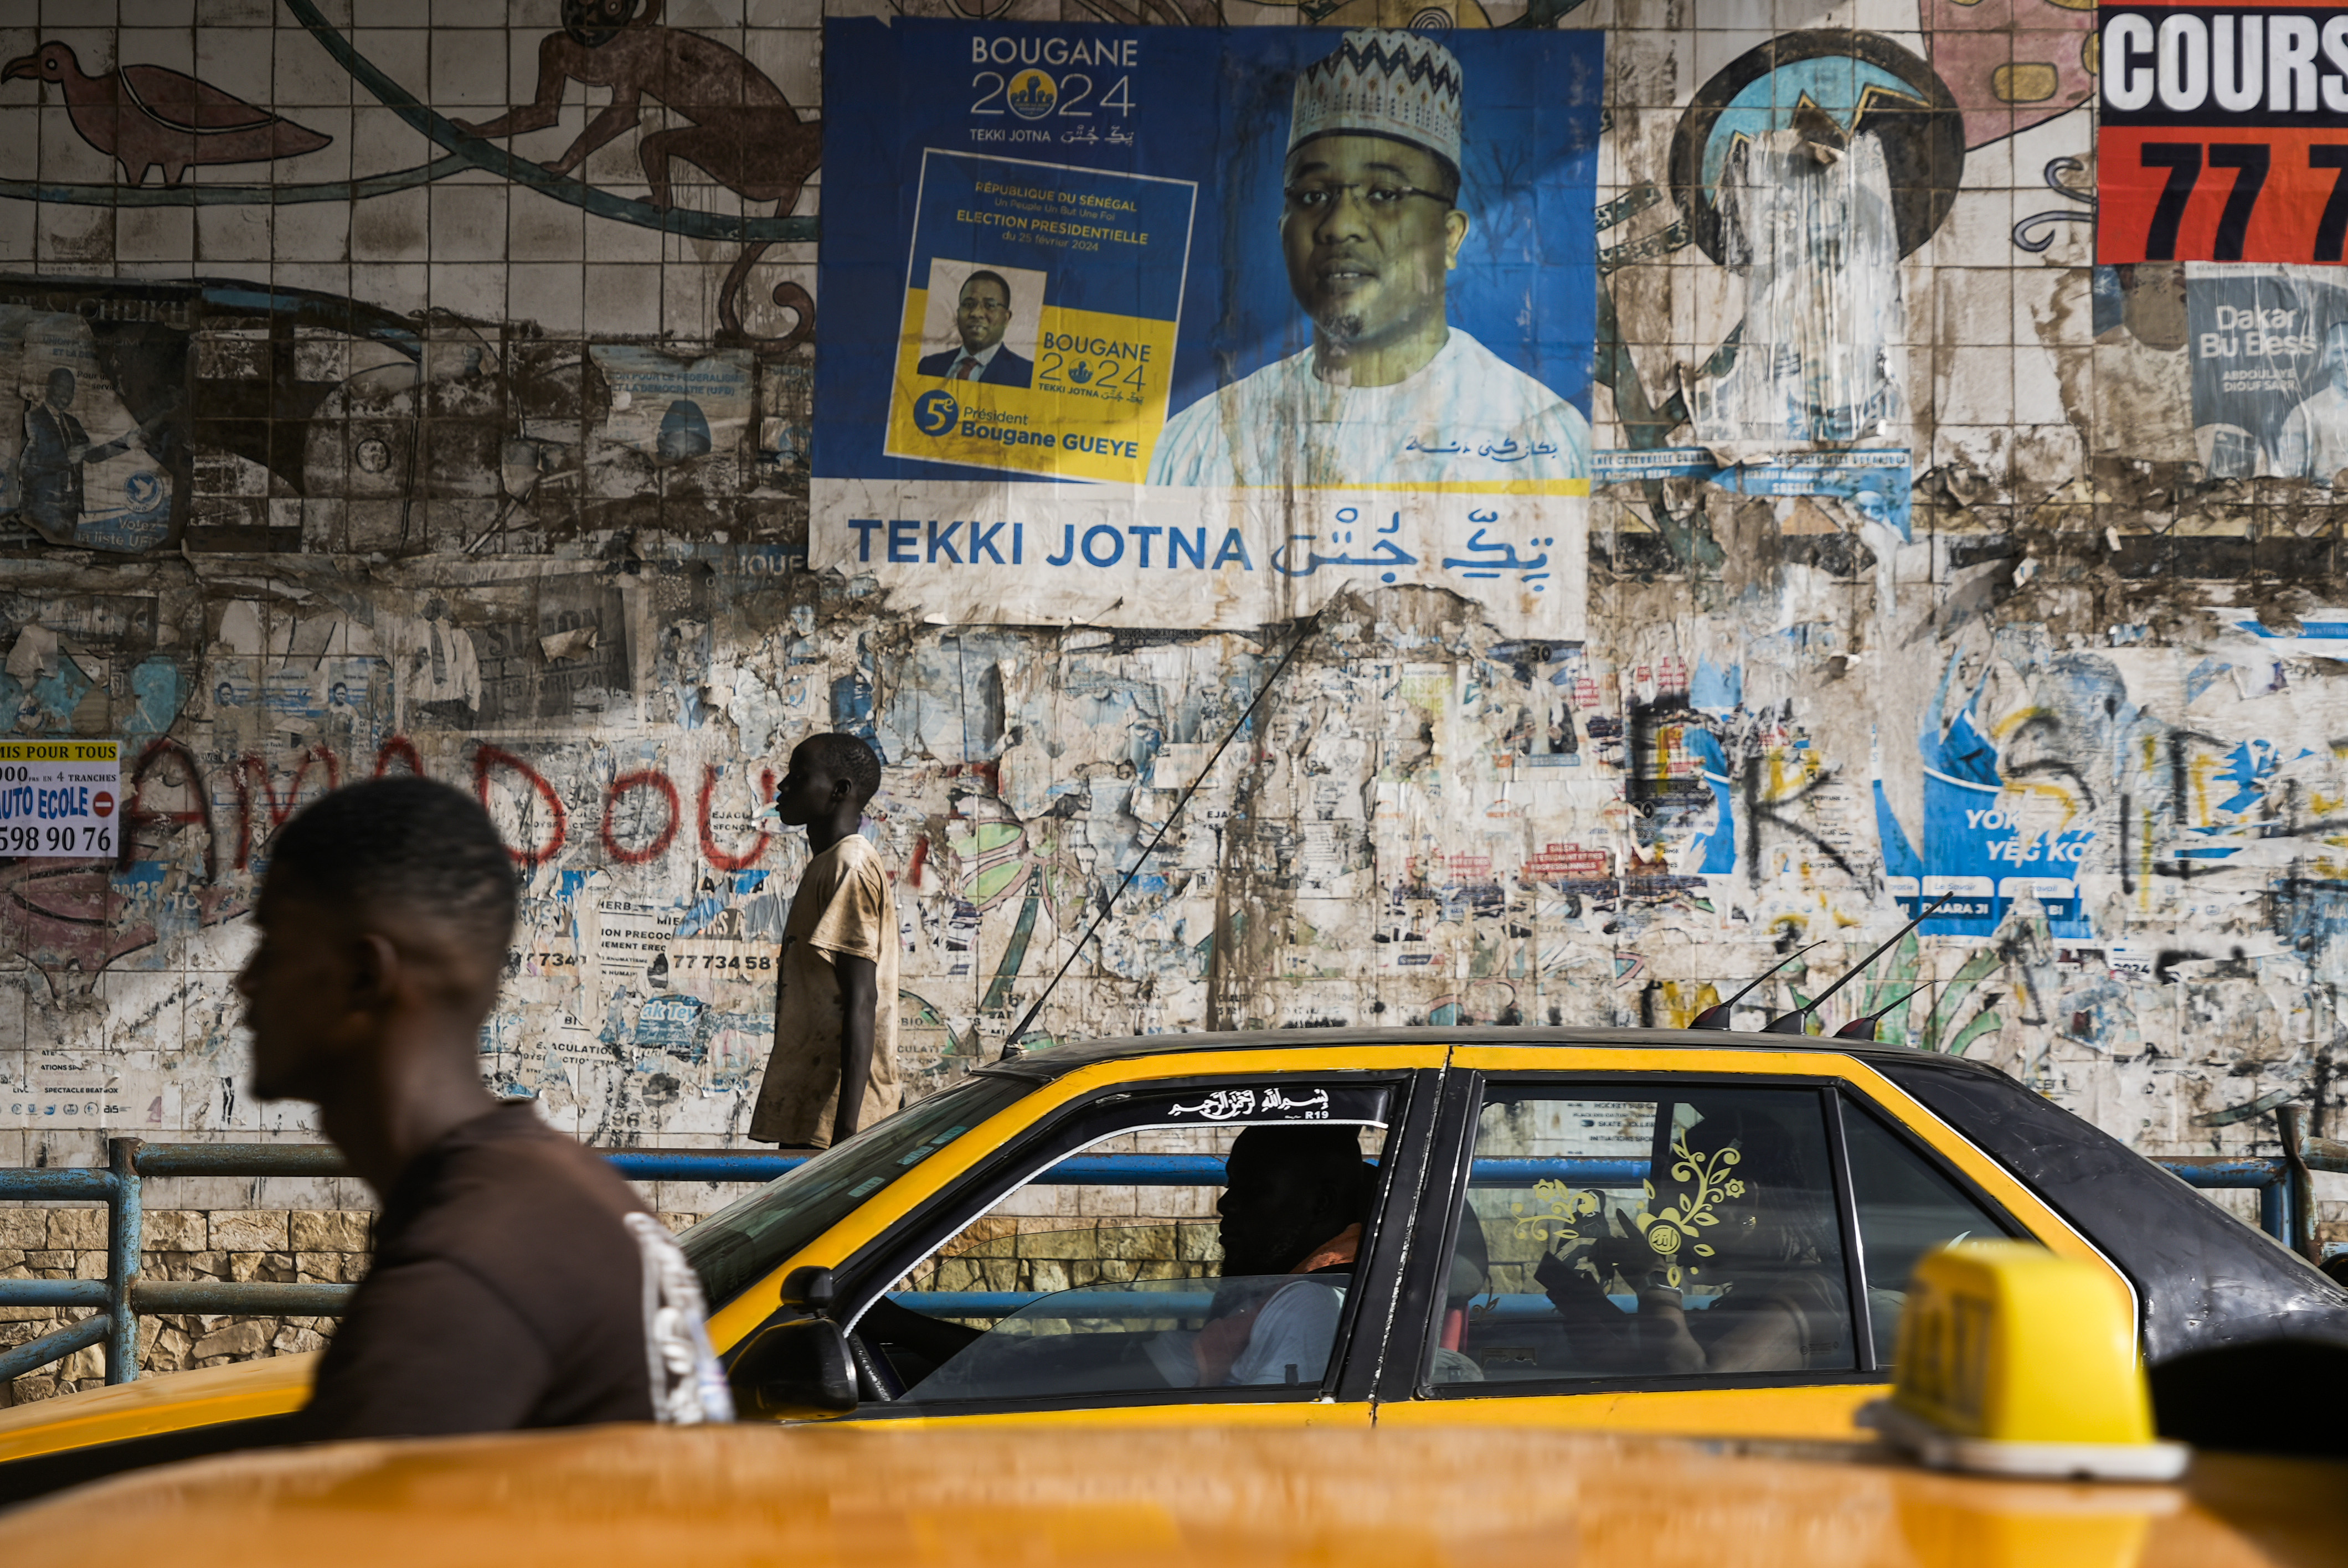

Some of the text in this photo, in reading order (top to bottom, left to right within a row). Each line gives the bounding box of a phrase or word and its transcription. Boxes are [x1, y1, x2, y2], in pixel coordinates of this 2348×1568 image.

[972, 36, 1139, 67] BOUGANE
[970, 128, 1051, 142] TEKKI JOTNA
[975, 181, 1137, 212] RÉPUBLIQUE DU SÉNÉGAL
[994, 198, 1115, 221] Un Peuple Un But Une Foi
[956, 209, 1149, 245] ELECTION PRESIDENTIELLE
[1002, 230, 1099, 252] du 25 février 2024
[2217, 305, 2298, 331] Dakar
[1043, 332, 1152, 363] BOUGANE
[2200, 332, 2239, 358] Bu
[78, 370, 98, 380] Pour
[1038, 382, 1099, 399] TEKKI JOTNA
[962, 405, 1028, 426] Président
[961, 421, 1139, 458] Bougane GUEYE
[118, 516, 157, 532] Votez
[78, 531, 90, 542] la
[94, 531, 124, 546] liste
[848, 517, 1253, 572] TEKKI JOTNA
[27, 746, 69, 759] POUR
[75, 746, 116, 759] TOUS
[0, 766, 28, 782] 00
[57, 771, 64, 782] 4
[0, 786, 87, 820] UTO ECOLE
[0, 826, 111, 851] 598 90 76
[2033, 884, 2058, 893] ravail
[1921, 903, 1989, 914] DAARA JI
[673, 955, 771, 970] 77 734 58
[1305, 1111, 1329, 1119] R19
